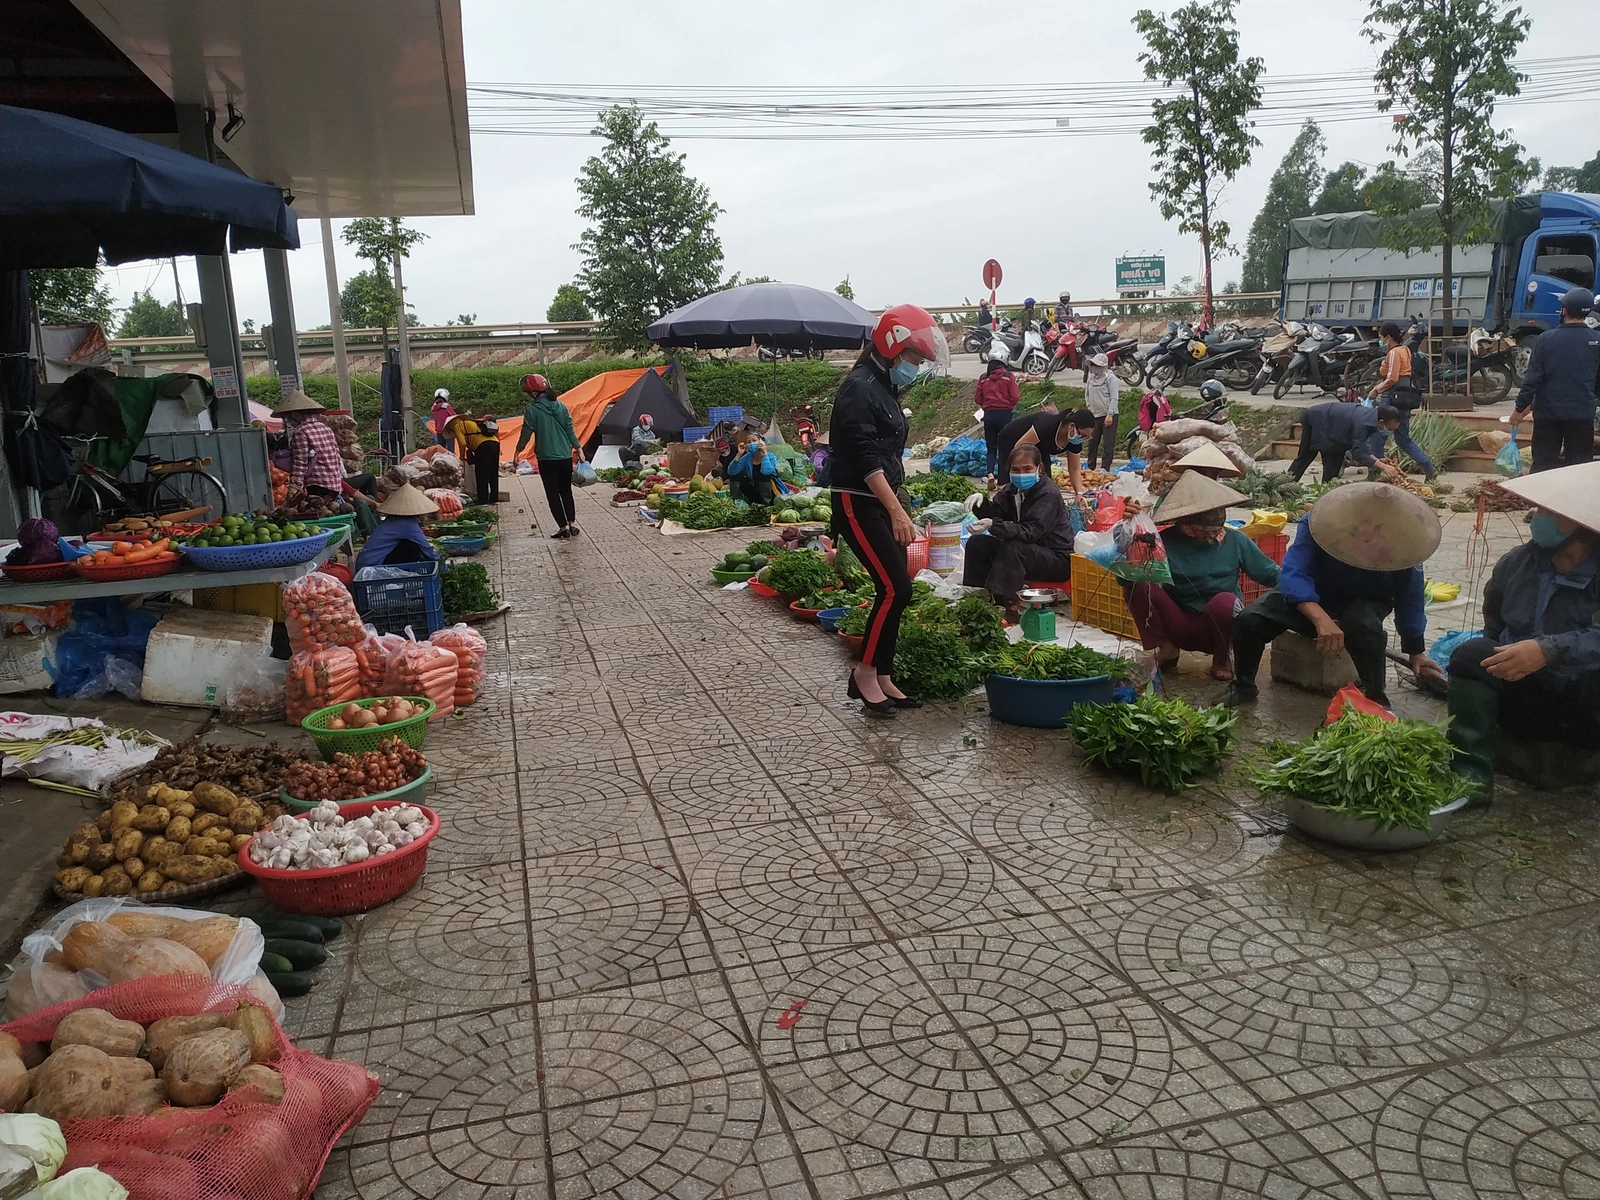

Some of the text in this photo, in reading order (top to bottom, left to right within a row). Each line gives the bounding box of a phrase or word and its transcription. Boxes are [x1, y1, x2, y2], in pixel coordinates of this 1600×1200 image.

[1121, 267, 1146, 278] NHẤT
[1436, 281, 1458, 290] HG
[1334, 304, 1344, 314] 143
